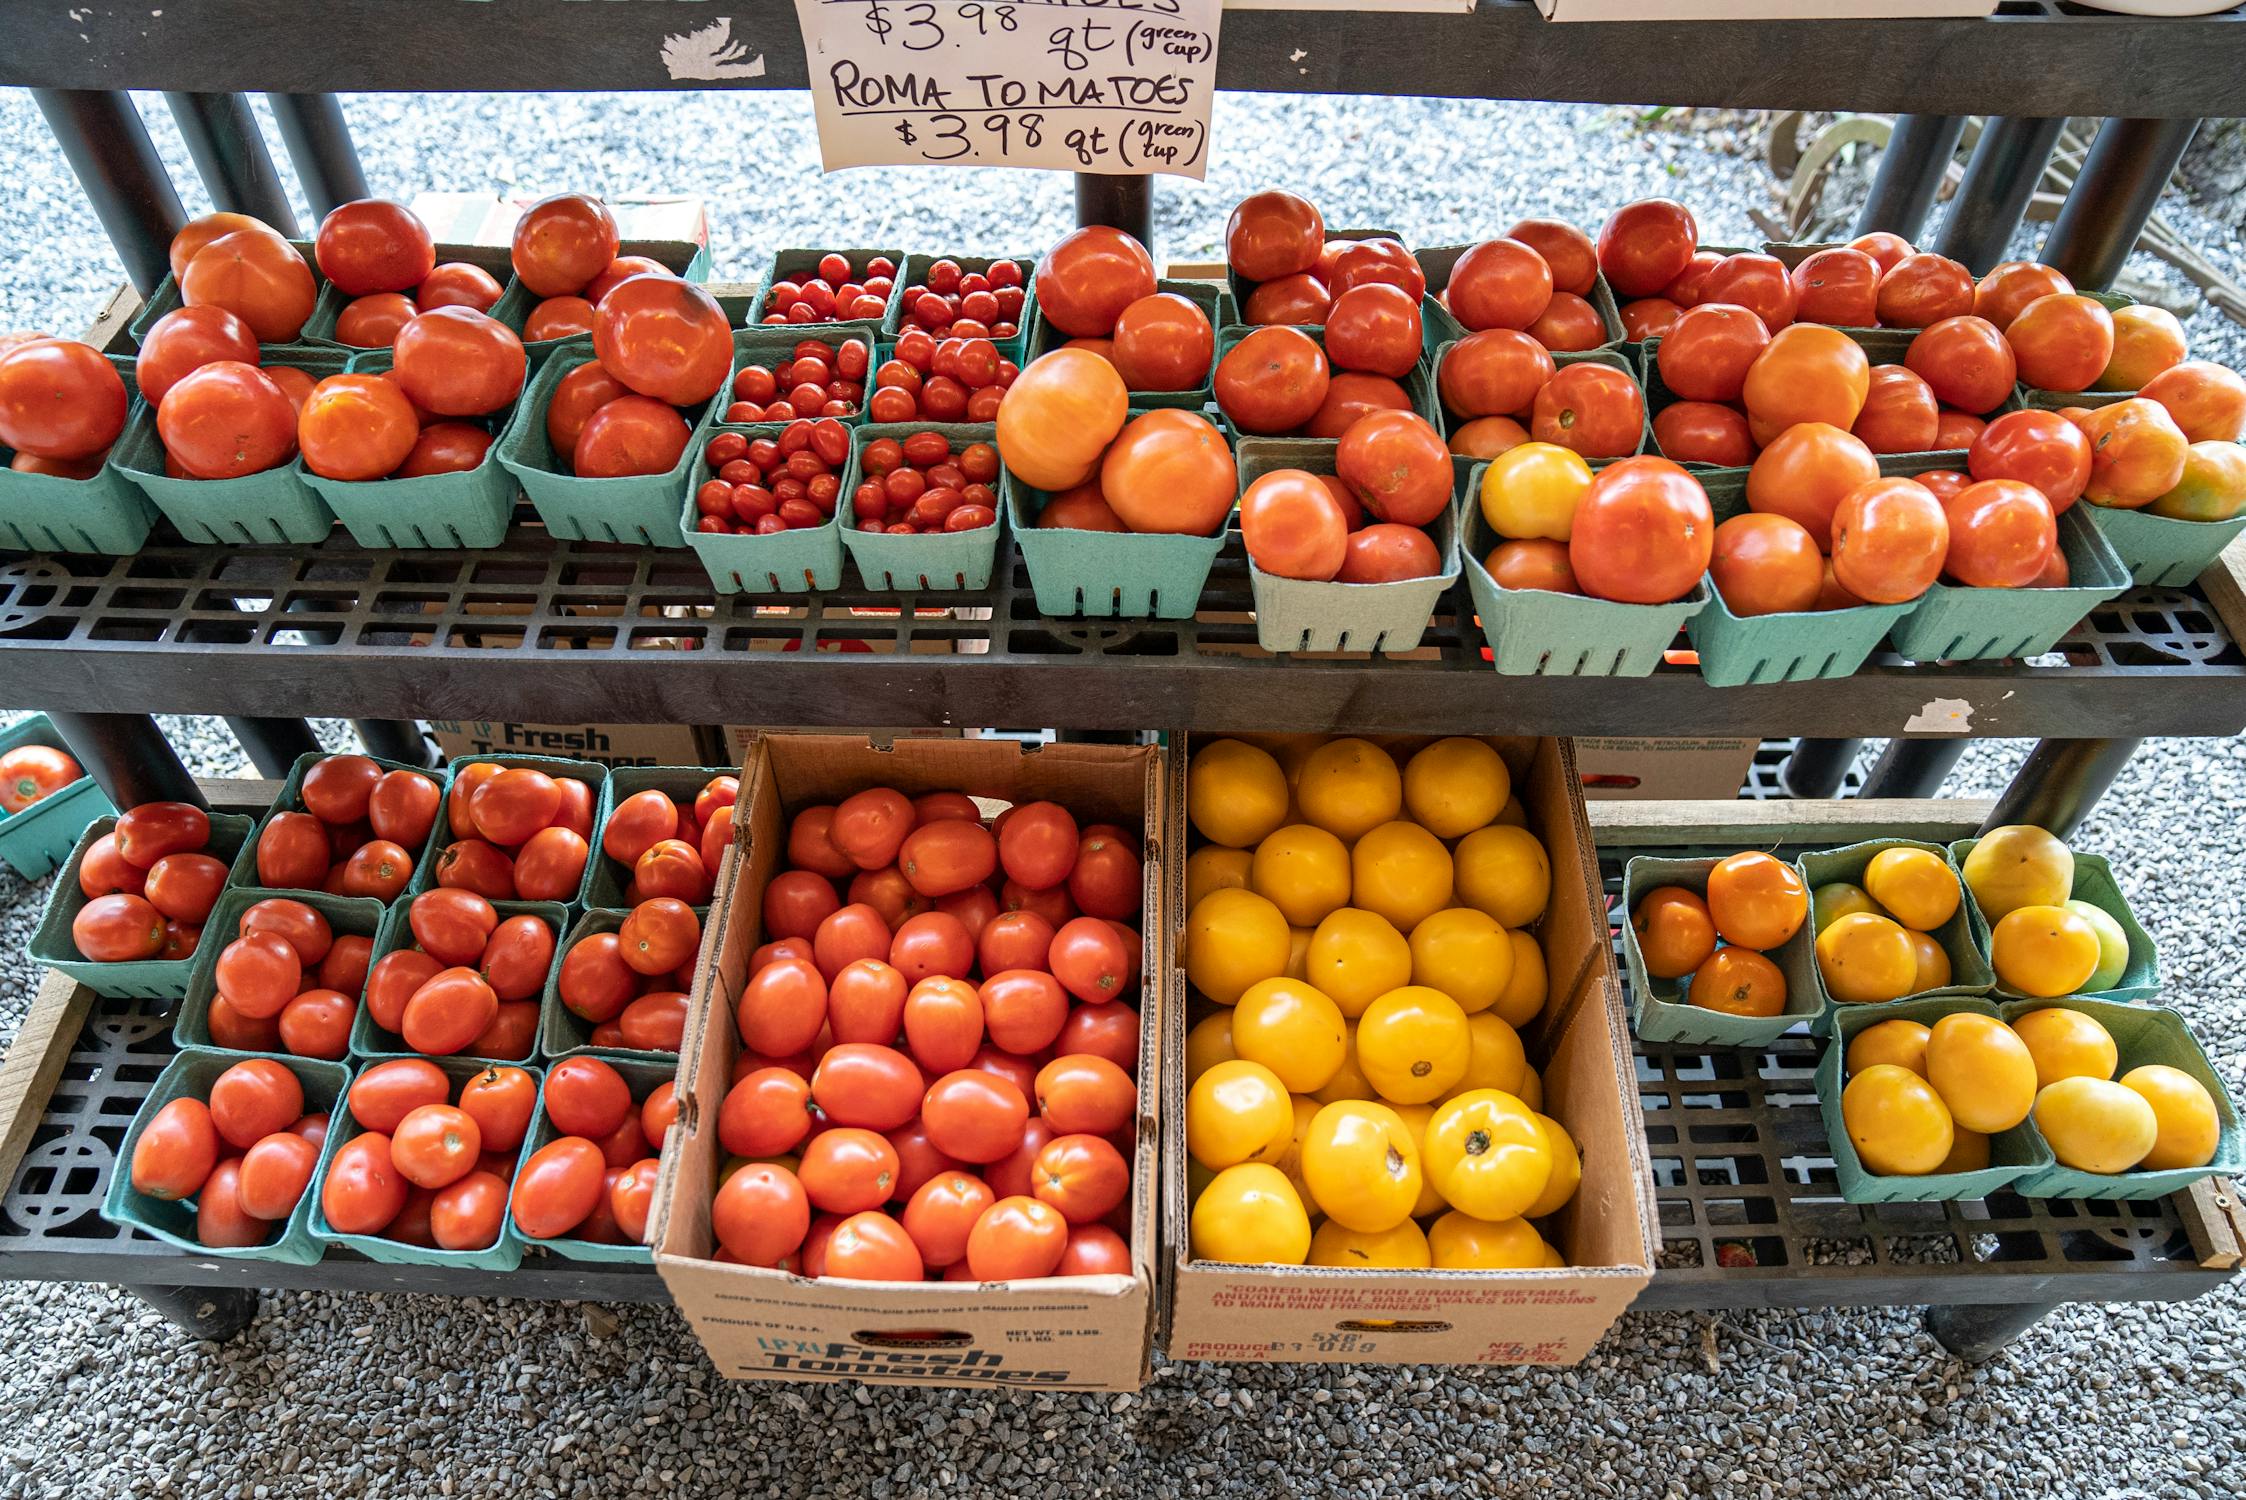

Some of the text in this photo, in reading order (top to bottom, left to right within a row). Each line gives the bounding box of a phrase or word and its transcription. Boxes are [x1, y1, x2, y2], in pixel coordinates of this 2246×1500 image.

[1047, 18, 1115, 70] qt
[830, 60, 1195, 110] ROMA TOMATOES
[894, 114, 1043, 160] $3.98
[1064, 127, 1110, 164] qt
[503, 722, 610, 751] Fresh
[1212, 1291, 1599, 1306] AND/OR MINERAL BASED WAXES OR RESINS
[1308, 1287, 1355, 1296] WITH
[1360, 1288, 1409, 1297] FOOD
[1414, 1288, 1475, 1298] GRADE
[1480, 1288, 1581, 1298] VEGETABLE
[1213, 1299, 1234, 1308] TO
[1238, 1301, 1325, 1311] MAINTAIN
[701, 1316, 762, 1327] PRODUCE
[1005, 1329, 1029, 1337] NET
[1187, 1342, 1273, 1352] PRODUCE
[825, 1343, 1004, 1367] Fresh
[1186, 1351, 1212, 1359] OF
[764, 1352, 1071, 1383] Tomatoes
